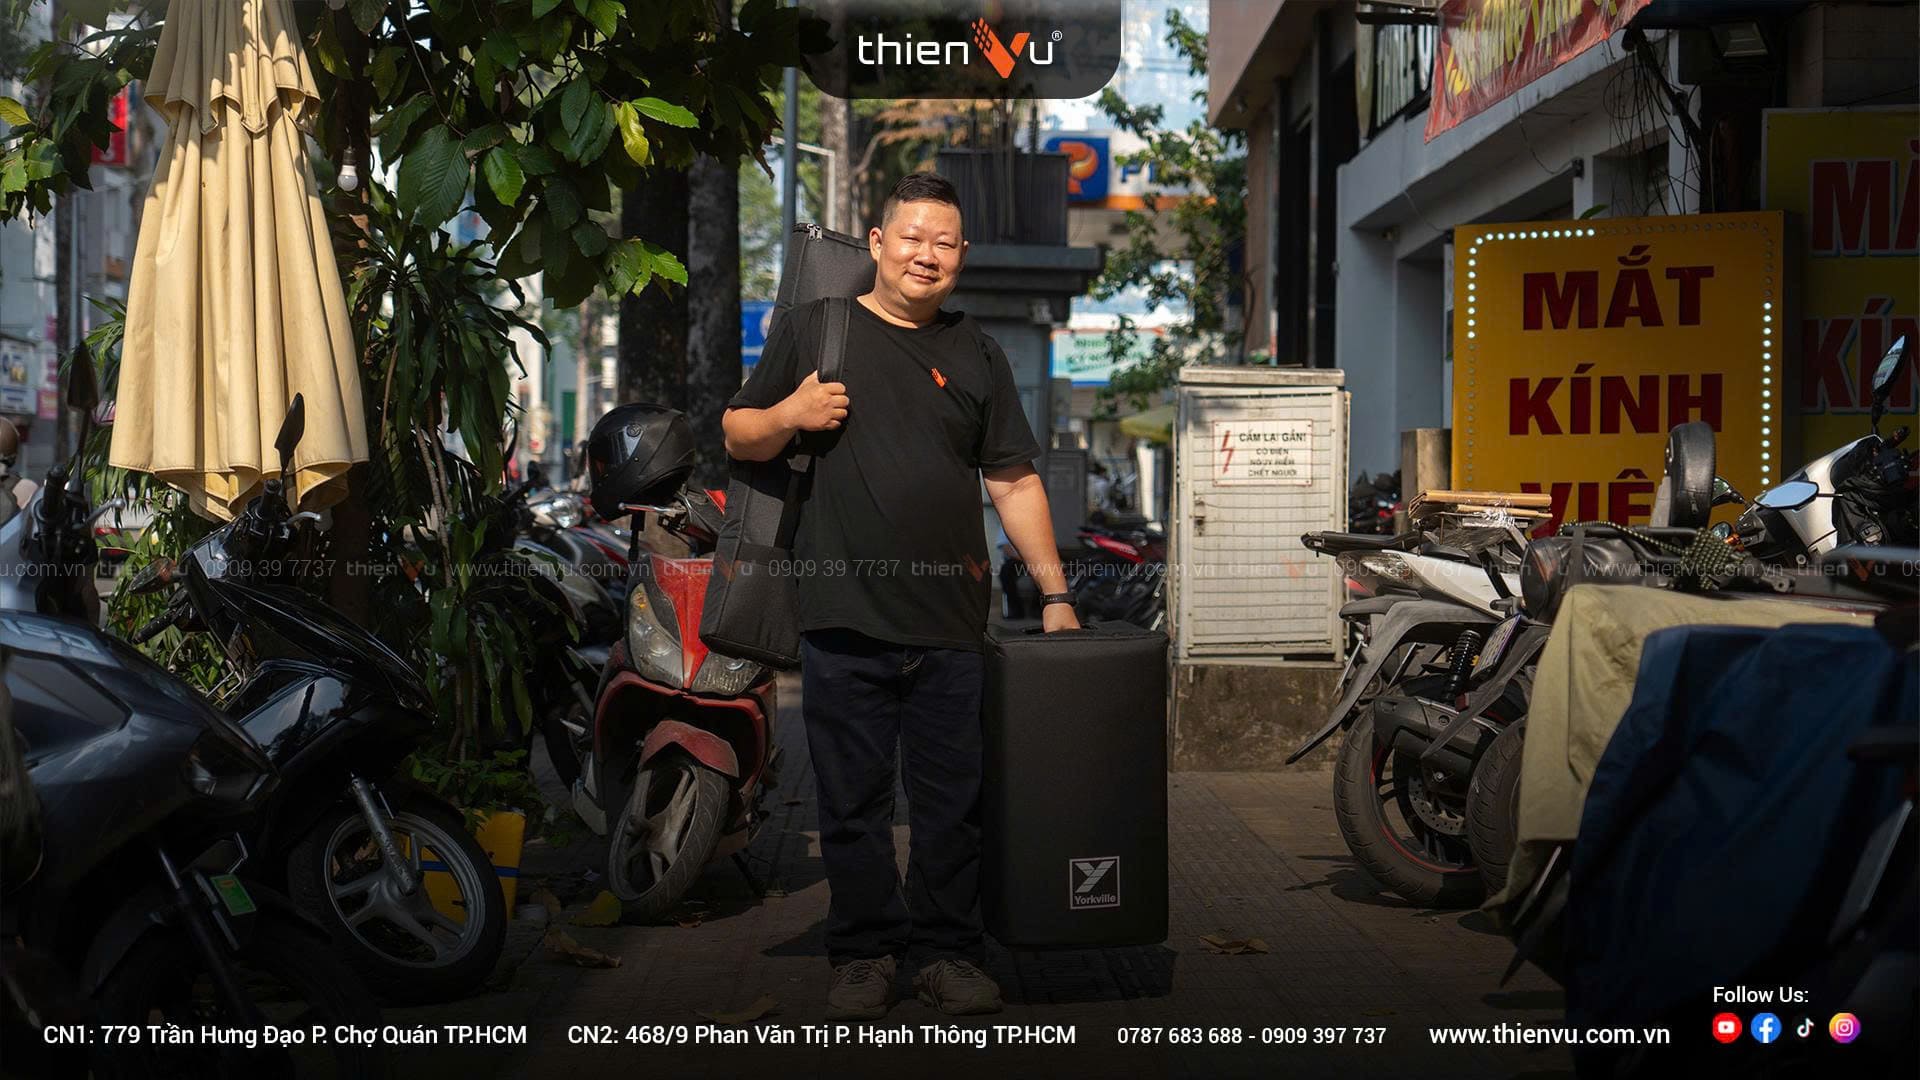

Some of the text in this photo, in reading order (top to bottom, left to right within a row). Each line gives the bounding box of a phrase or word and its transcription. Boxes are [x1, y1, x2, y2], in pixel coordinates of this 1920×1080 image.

[1523, 244, 1715, 331] MẮT
[1509, 363, 1723, 436] KÍNH
[1073, 894, 1117, 905] Yorkville
